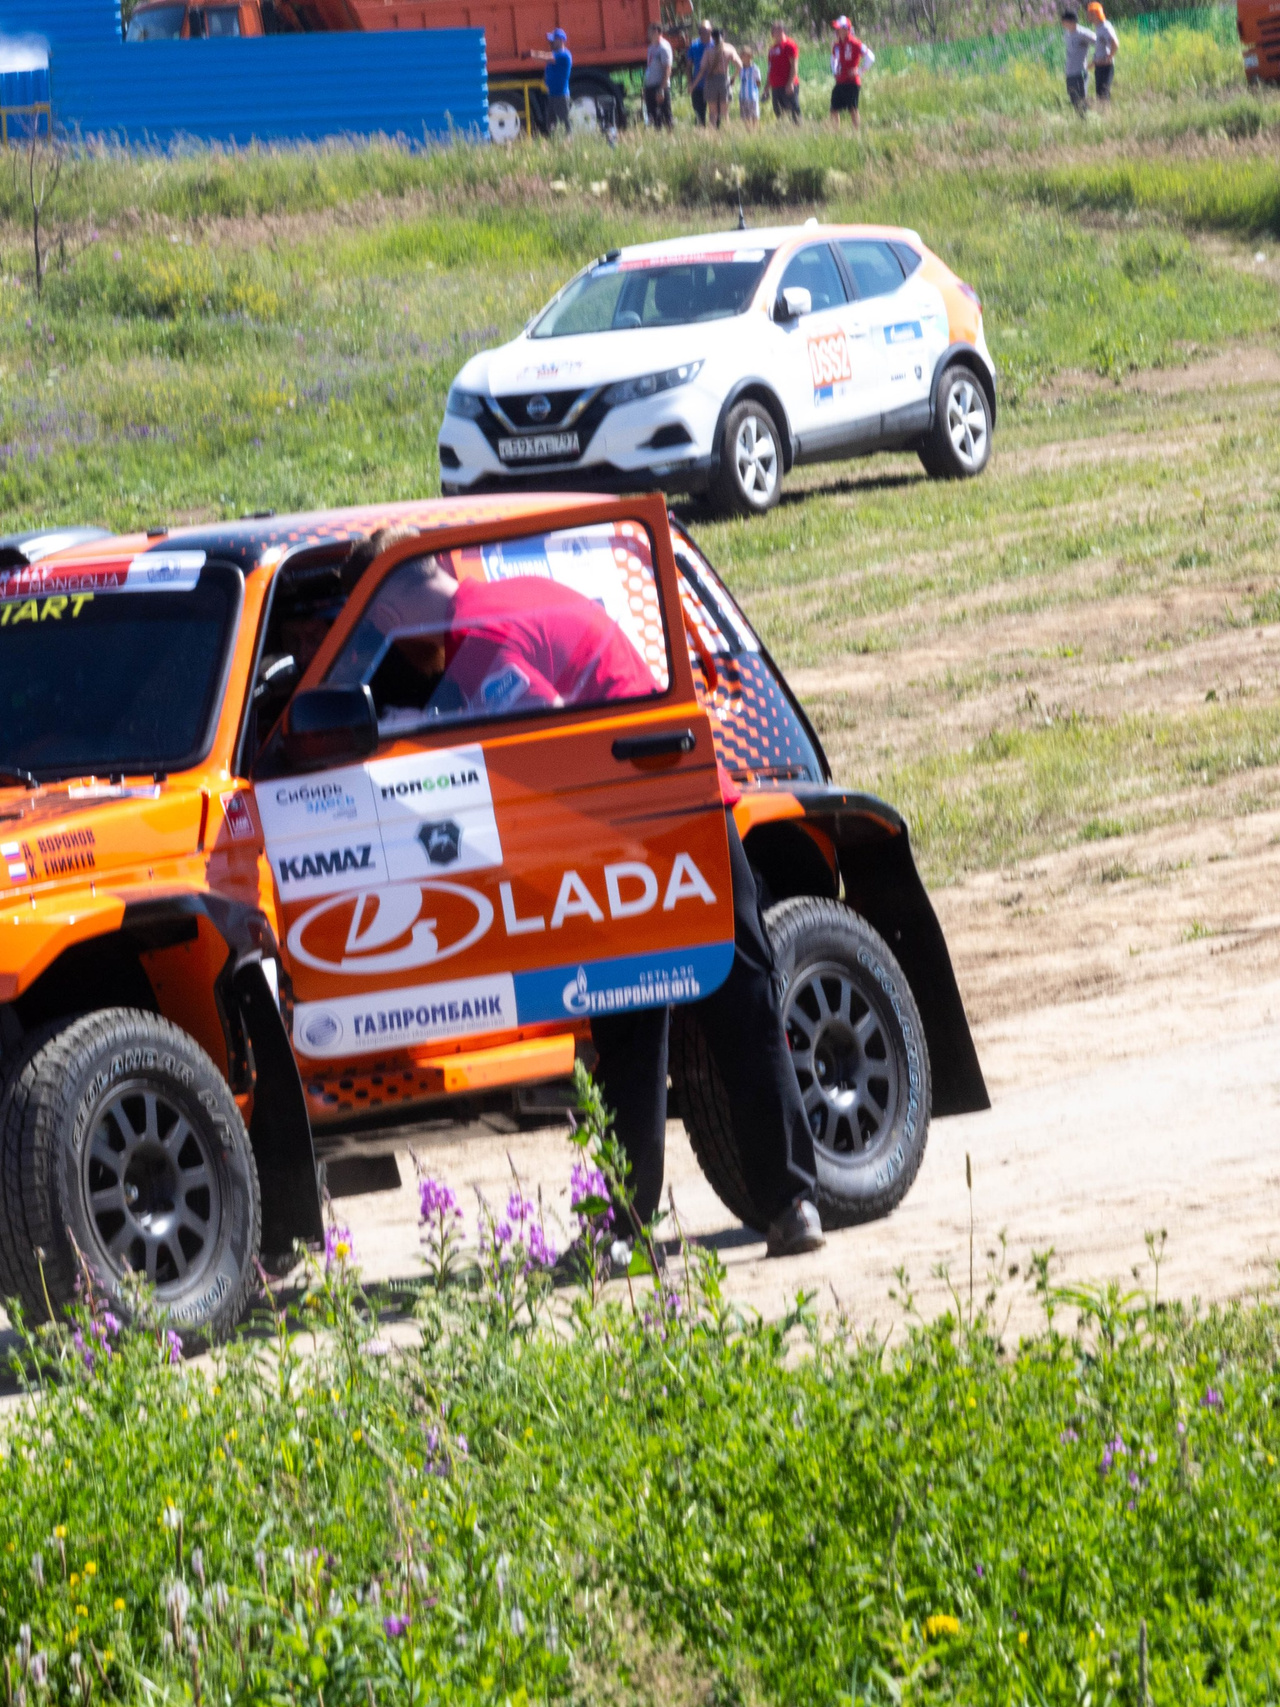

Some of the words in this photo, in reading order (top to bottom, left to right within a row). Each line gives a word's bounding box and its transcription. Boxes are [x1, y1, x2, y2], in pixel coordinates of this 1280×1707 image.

[28, 572, 120, 598] MONGOLIA
[276, 781, 343, 805] Сибирь
[279, 844, 375, 883] KAMAZ
[499, 852, 717, 937] LADA
[640, 969, 669, 984] СЕТЬ
[671, 964, 695, 980] АЗС
[591, 977, 701, 1012] ГАЗПРОМНЕФТЬ
[353, 994, 503, 1037] ГАЗПРОМБАНК
